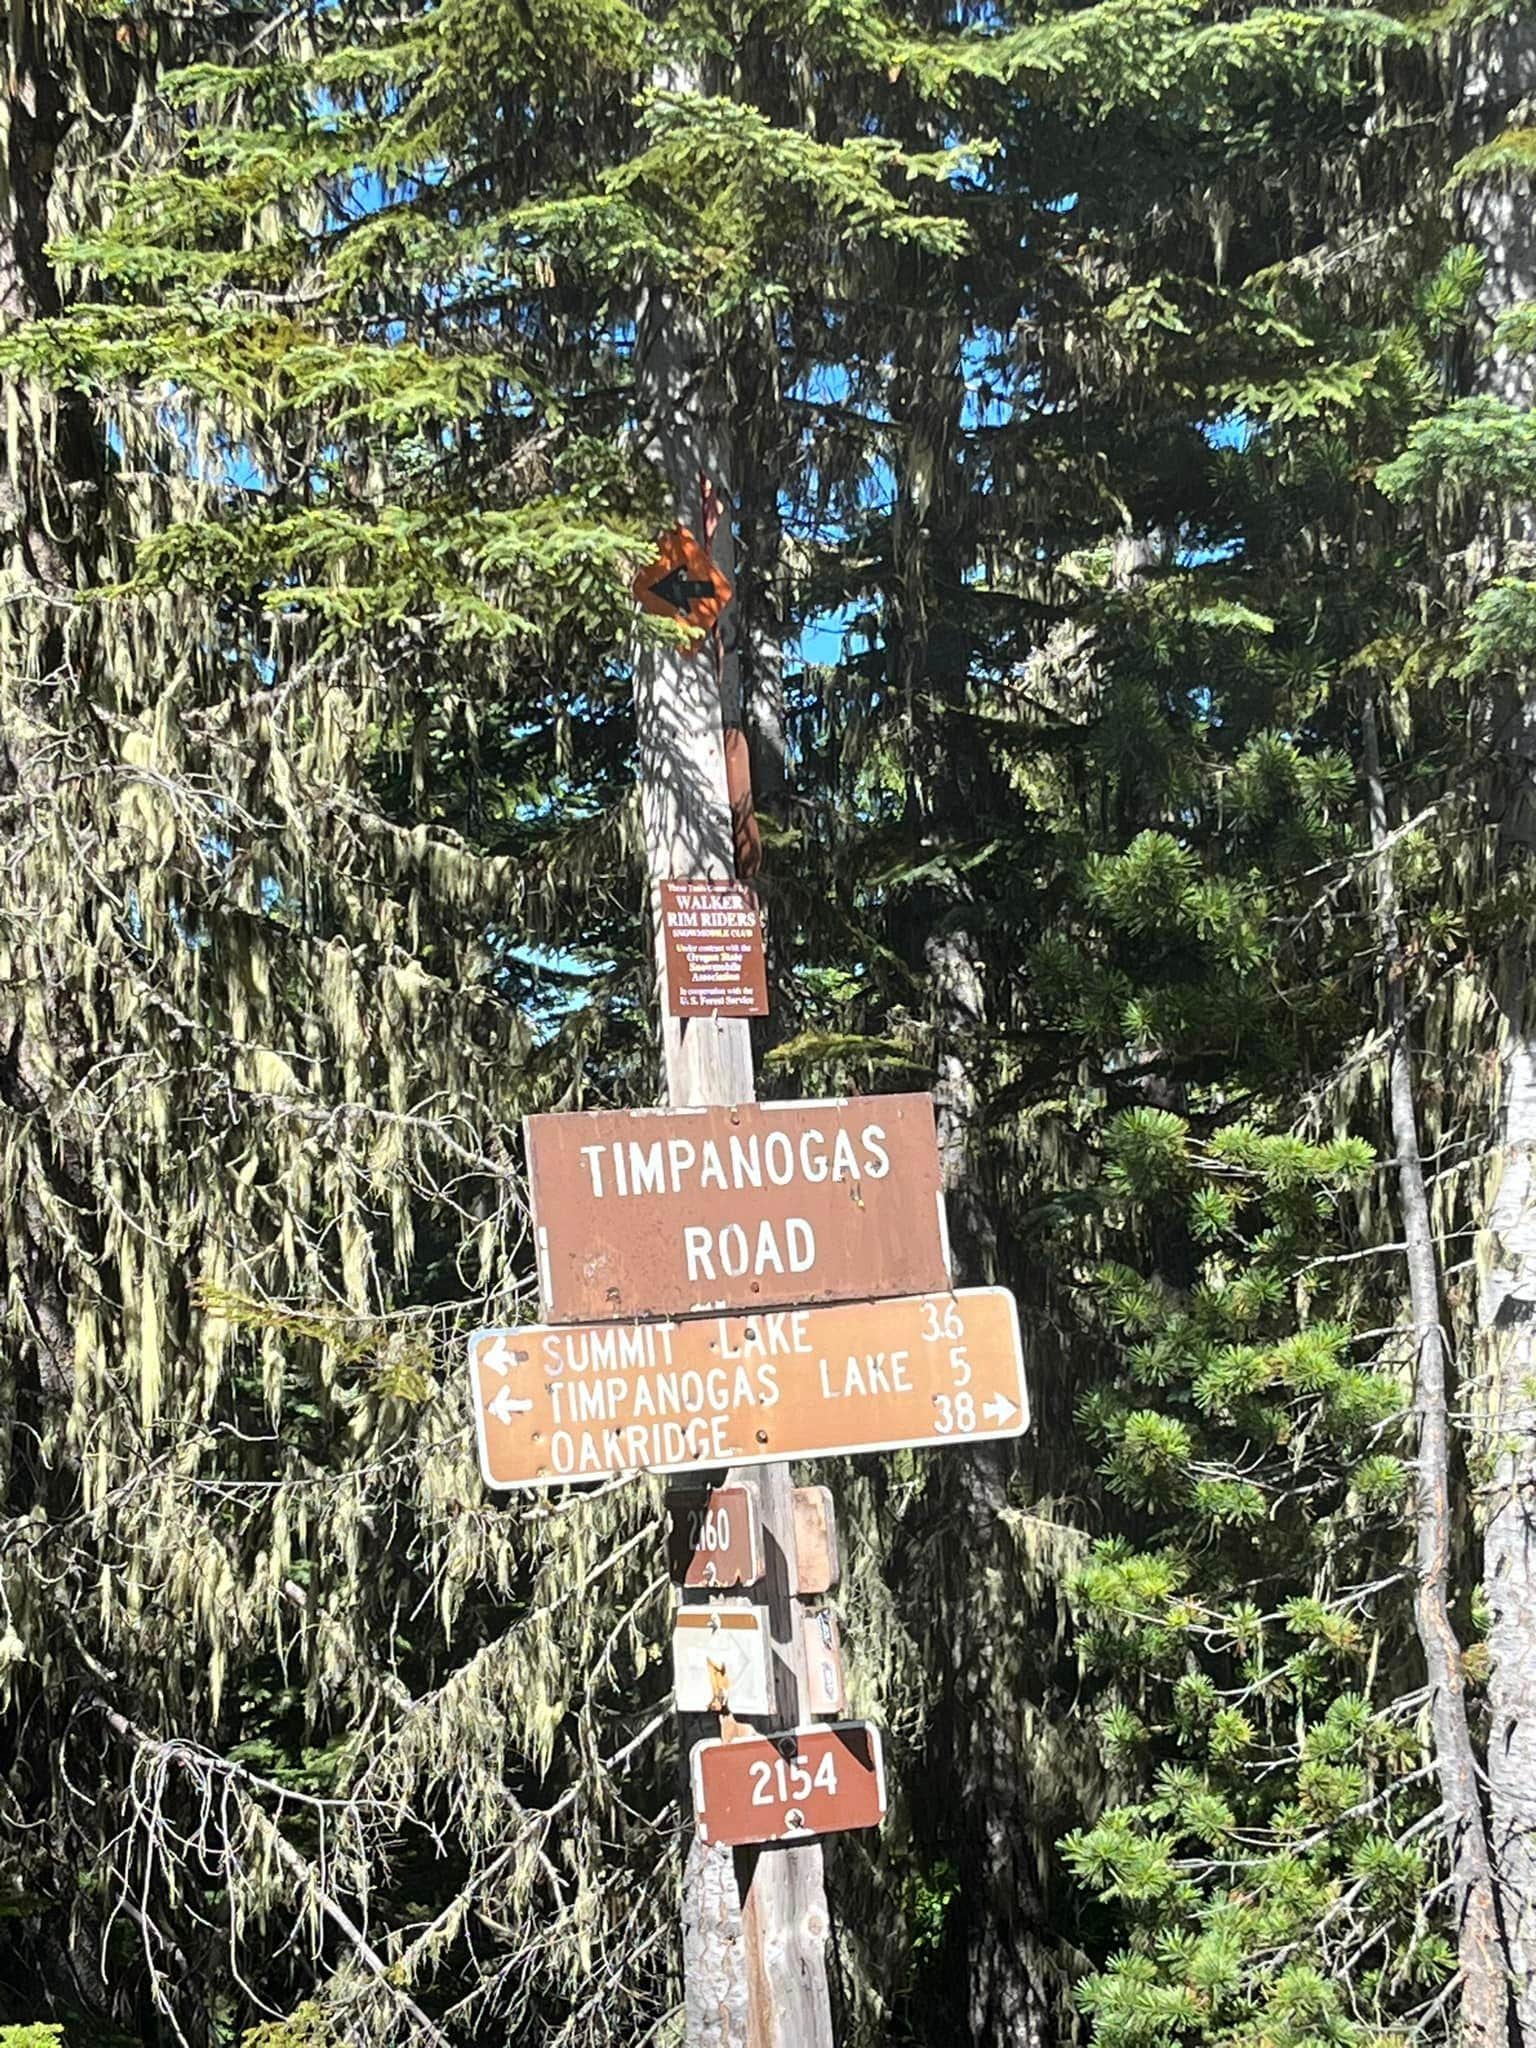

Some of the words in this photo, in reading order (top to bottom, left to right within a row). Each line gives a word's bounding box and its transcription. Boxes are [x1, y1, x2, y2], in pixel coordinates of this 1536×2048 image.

[676, 895, 744, 909] WALKER
[667, 912, 698, 927] RIM
[701, 912, 756, 927] RIDERS
[672, 929, 729, 938] SNOWMOBILE
[730, 929, 753, 938] CLUB
[676, 944, 697, 952] Under
[698, 944, 725, 952] contract
[726, 944, 740, 952] with
[741, 944, 751, 952] the
[687, 953, 719, 964] Oregon
[720, 953, 743, 962] State
[689, 963, 741, 972] Snowmobile
[692, 973, 740, 982] Association
[680, 987, 687, 995] In
[727, 987, 742, 995] with
[743, 987, 754, 995] the
[700, 996, 725, 1006] Forest
[726, 996, 755, 1006] Service
[580, 1124, 891, 1199] TIMPANOGAS
[683, 1217, 816, 1281] ROAD
[542, 1322, 675, 1377] SUMMIT
[719, 1309, 813, 1359] LAKE
[549, 1363, 780, 1424] TIMPANOGAS
[820, 1350, 913, 1399] LAKE
[949, 1345, 972, 1387] 5
[551, 1415, 735, 1473] OAKRIDGE
[933, 1391, 977, 1433] 38
[687, 1507, 730, 1552] 2160
[748, 1751, 838, 1806] 2154
